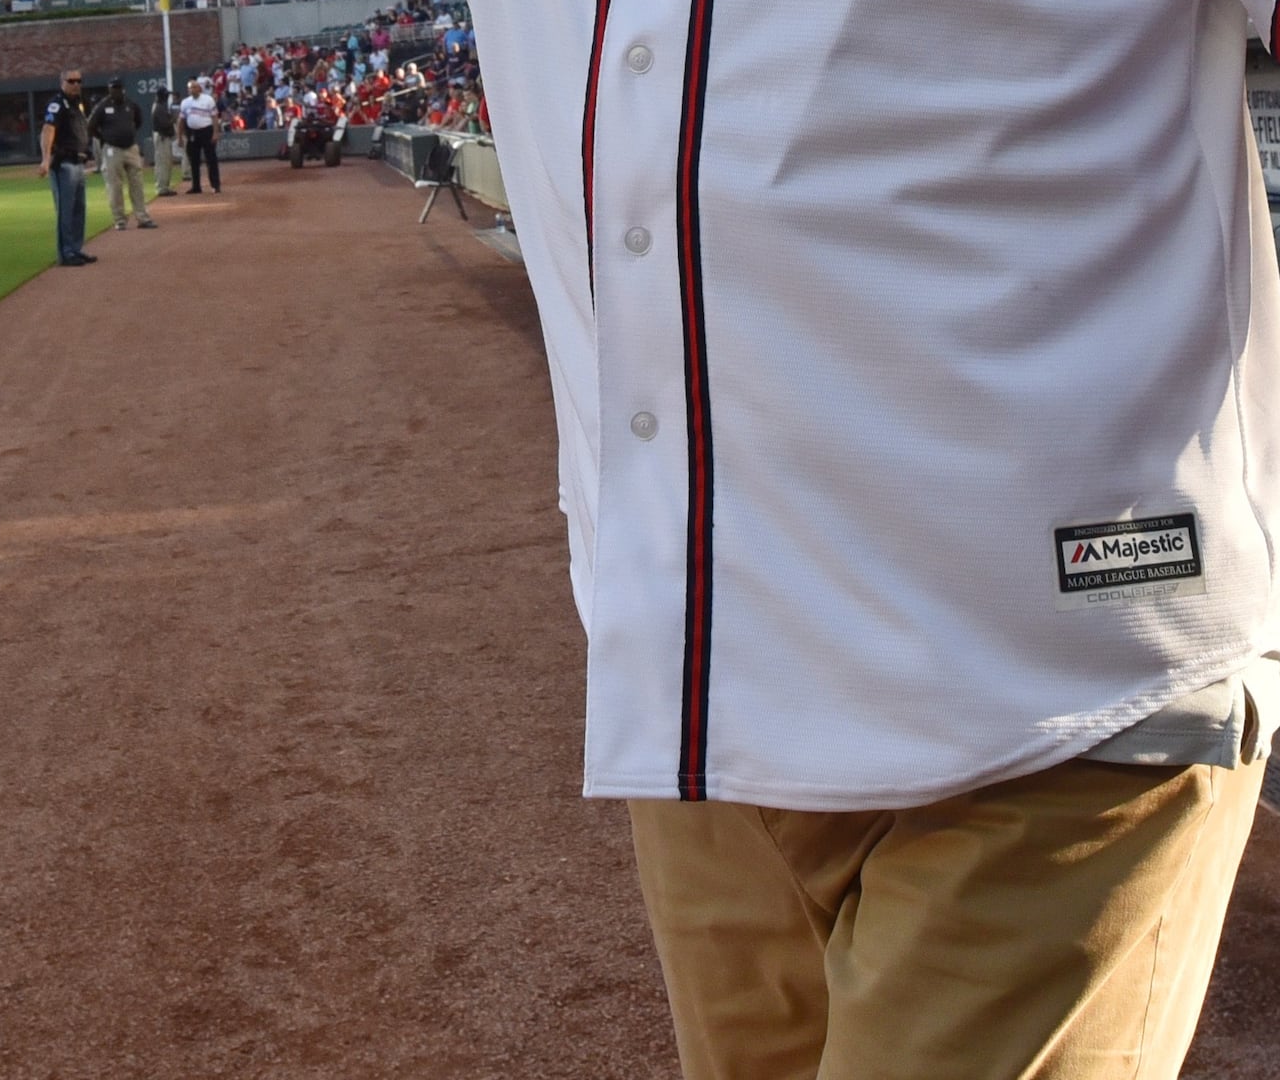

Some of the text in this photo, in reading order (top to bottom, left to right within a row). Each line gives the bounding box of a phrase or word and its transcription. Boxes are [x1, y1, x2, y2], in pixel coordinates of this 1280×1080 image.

[1101, 532, 1185, 563] Majestic
[1067, 575, 1104, 589] MAJOR
[1105, 569, 1146, 584] LEAGUE
